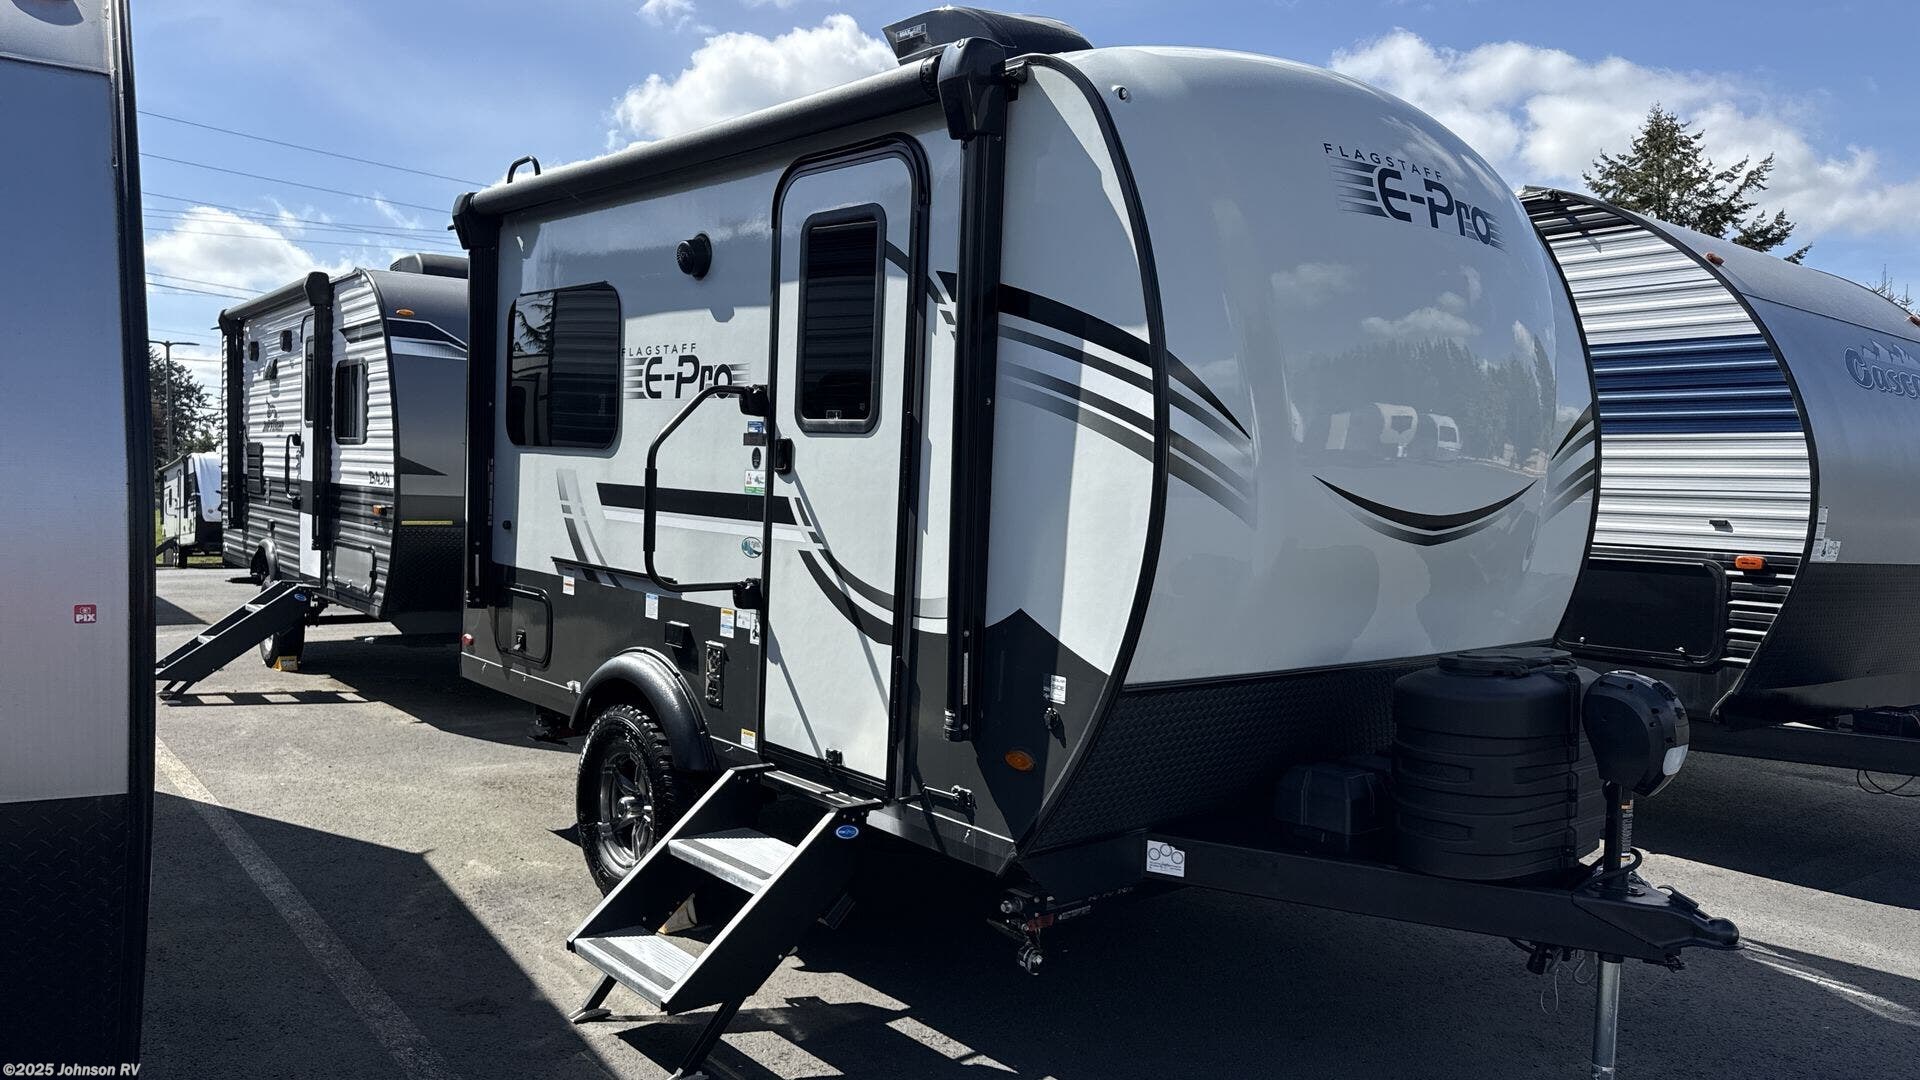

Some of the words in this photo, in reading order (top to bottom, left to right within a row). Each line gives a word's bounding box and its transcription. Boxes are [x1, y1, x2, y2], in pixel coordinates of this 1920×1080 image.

[1323, 142, 1442, 181] FLAGSTAFF
[1377, 167, 1492, 245] E-Pro
[621, 342, 697, 357] FLAGSTAFF
[645, 354, 733, 399] E-Pro
[75, 613, 96, 622] PIX
